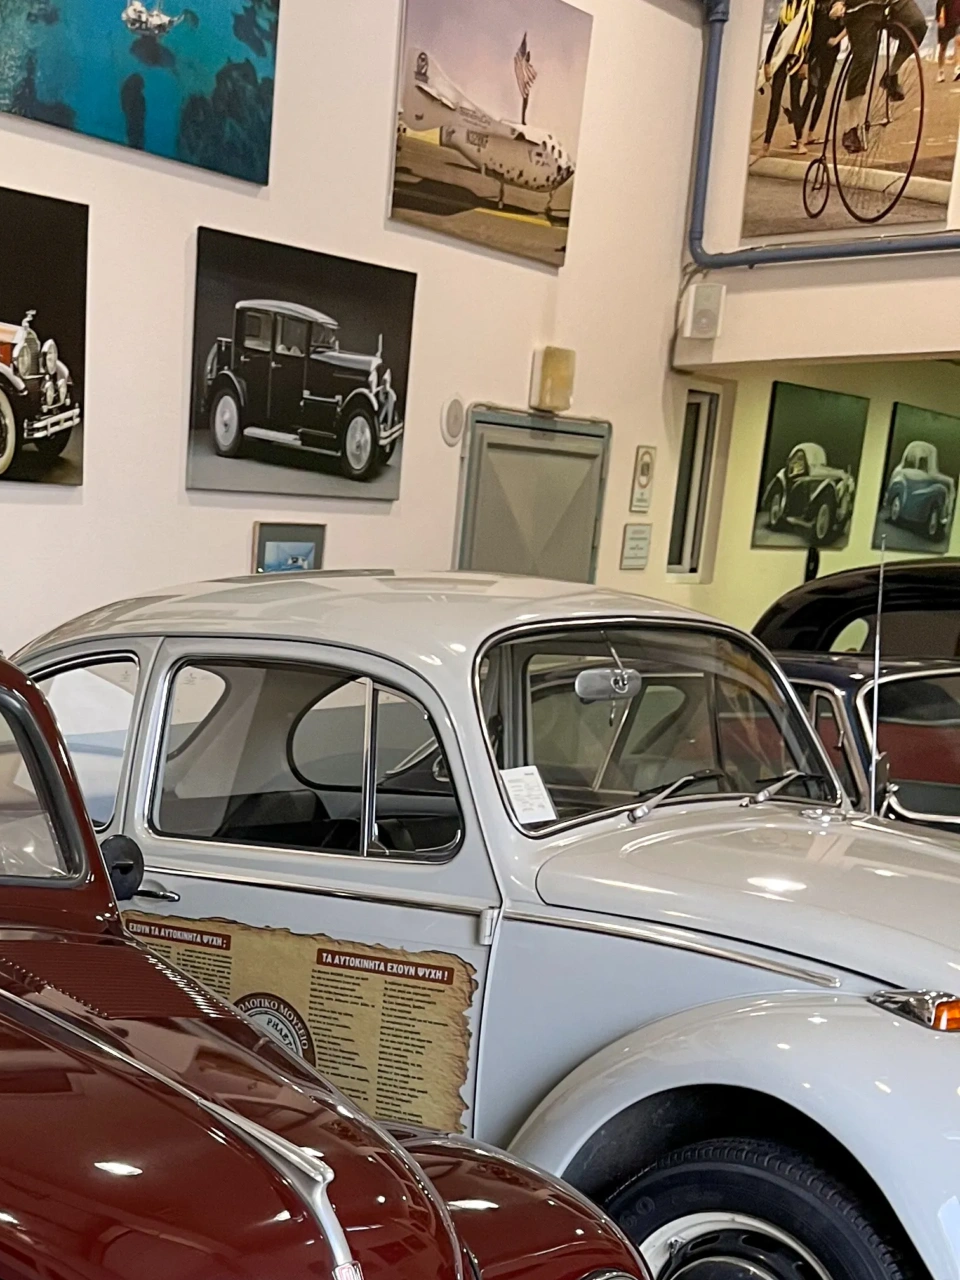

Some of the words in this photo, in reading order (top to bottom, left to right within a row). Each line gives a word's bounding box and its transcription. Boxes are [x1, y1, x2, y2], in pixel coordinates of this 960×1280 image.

[128, 922, 150, 934] ΕΧΟΥΝ
[151, 926, 159, 936] ΤΑ
[160, 927, 201, 943] ΑΥΤΟΚΙΝΗΤΑ
[202, 935, 222, 947] ΨΥΧΗ
[322, 952, 332, 964] ΤΑ
[334, 954, 385, 972] ΑΥΤΟΚΙΝΗΤΑ
[387, 964, 415, 978] ΕΧΟΥΝ
[417, 968, 442, 981] ΨΥΧΗ
[239, 998, 278, 1012] ΟΛΟΓΙΚΟ
[278, 1004, 309, 1050] ΜΟΥΣΕΙΟ
[266, 1017, 294, 1048] PHAET
